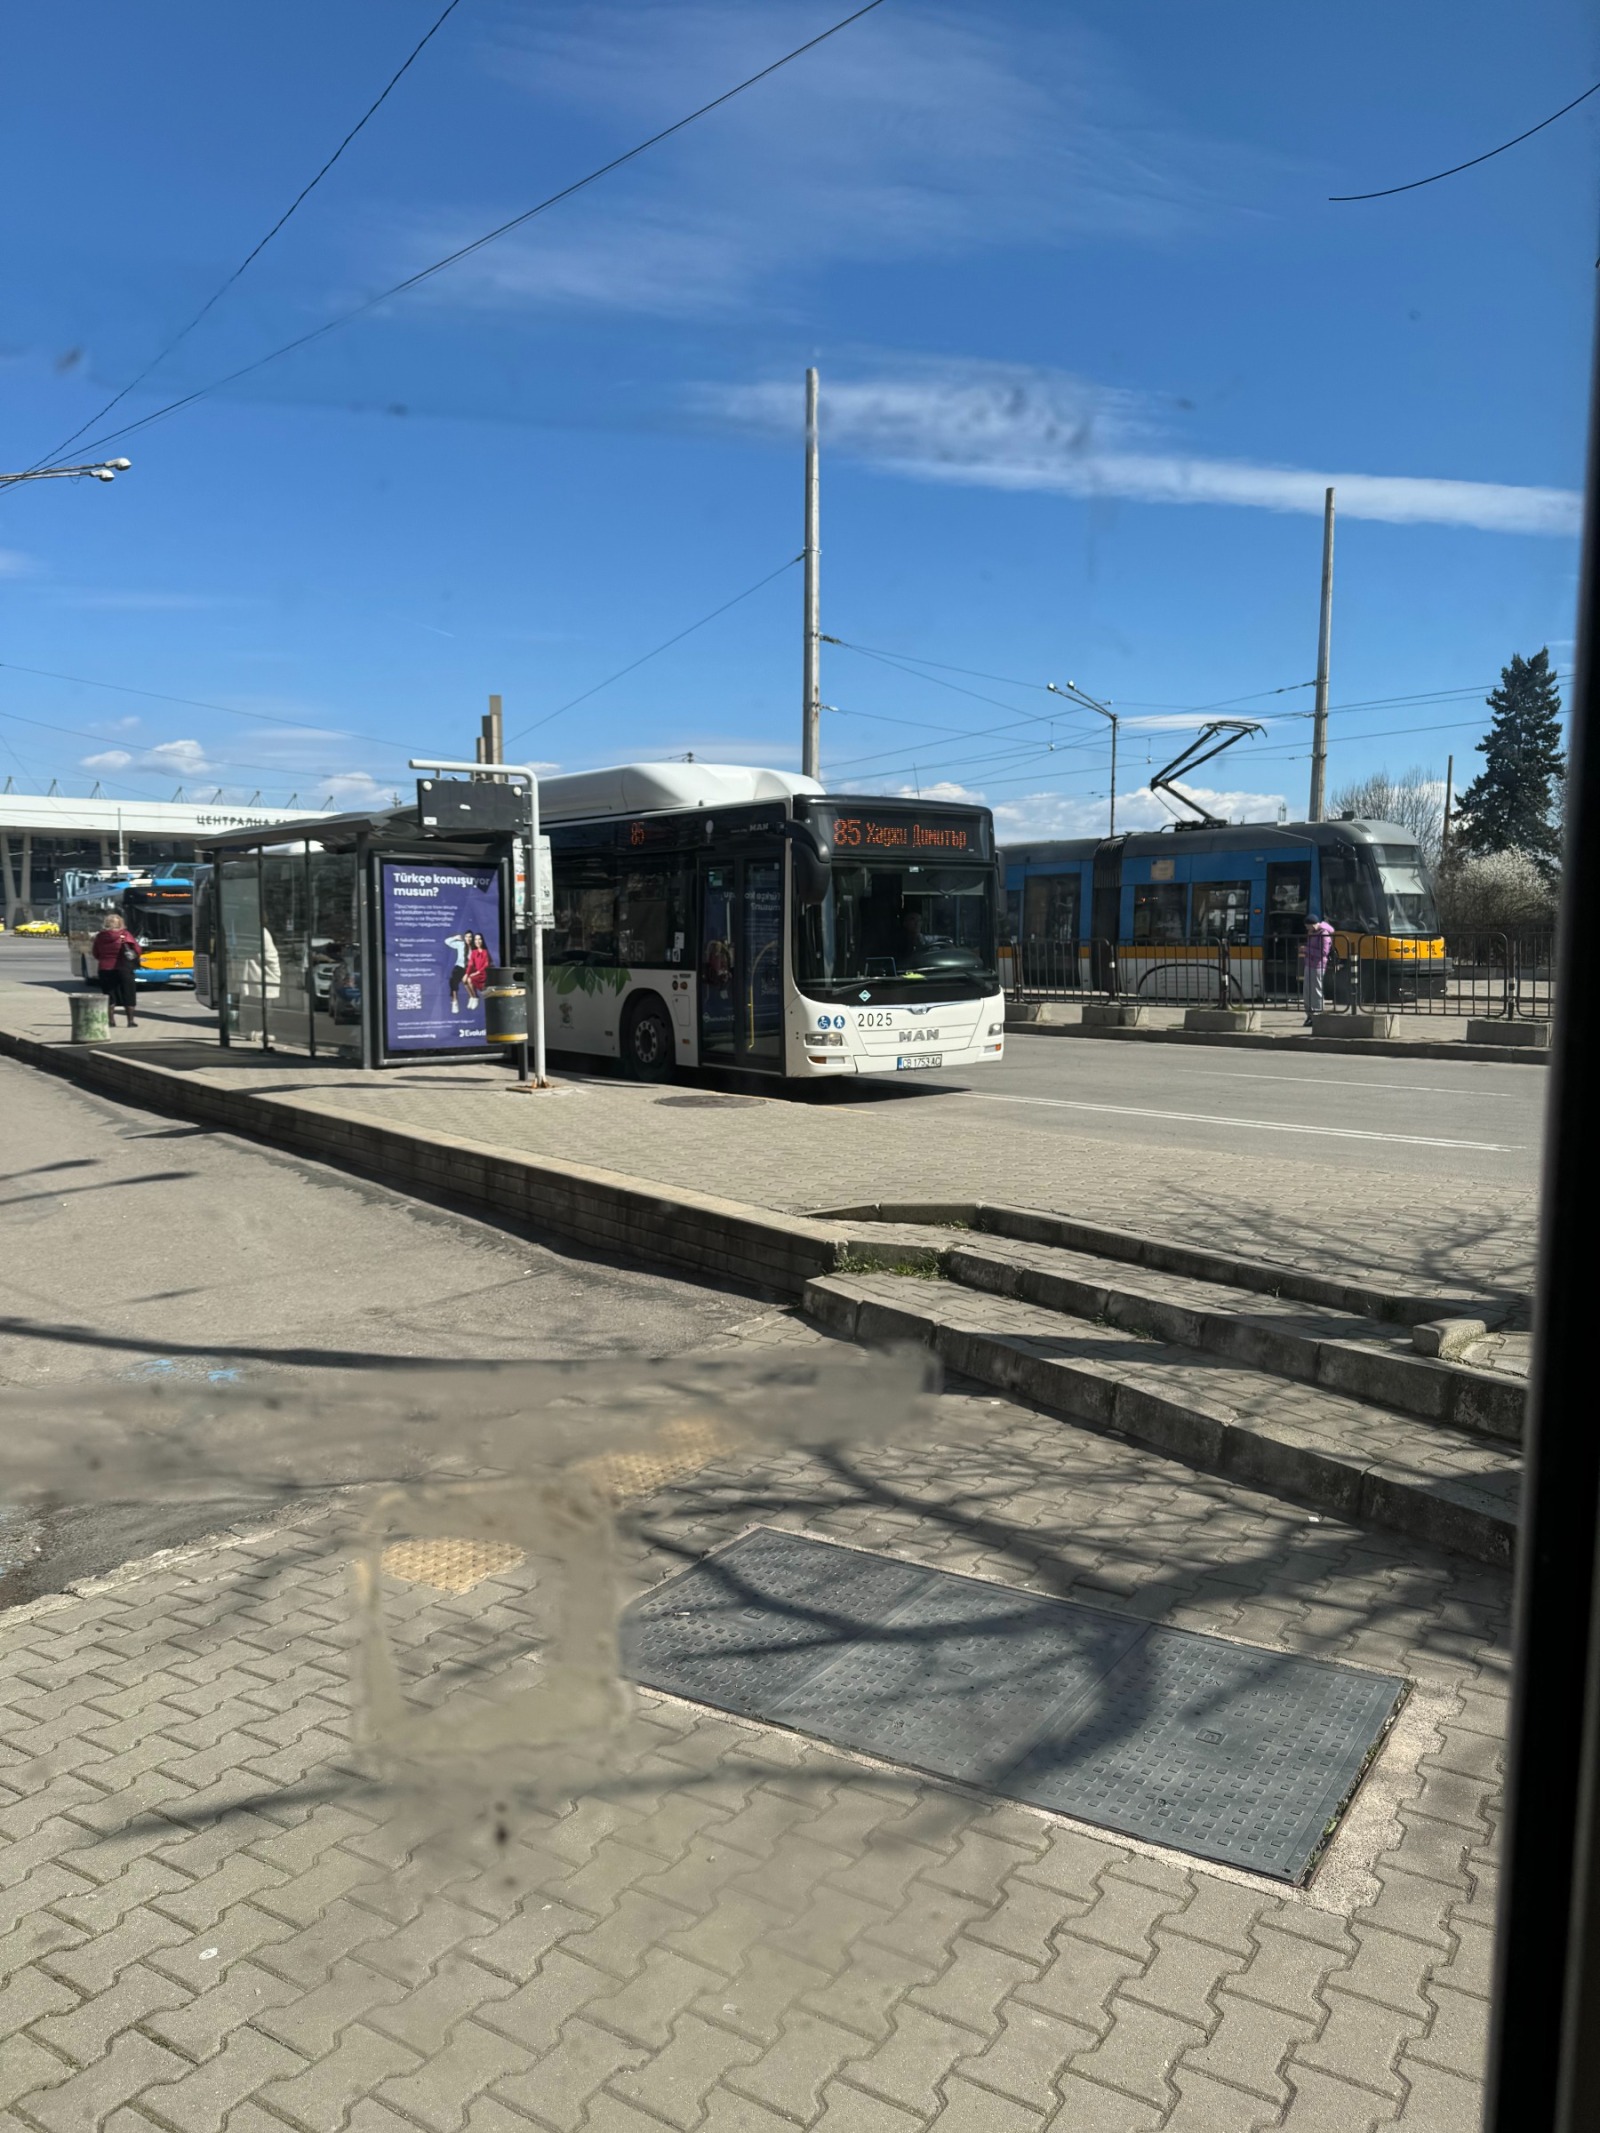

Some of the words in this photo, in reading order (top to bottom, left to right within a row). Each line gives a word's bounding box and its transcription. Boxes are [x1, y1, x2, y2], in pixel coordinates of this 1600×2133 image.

[632, 822, 645, 845] 85
[834, 819, 861, 846] 85
[866, 822, 908, 847] Хаджи
[913, 824, 967, 849] Димитър
[393, 872, 432, 887] Türkçe
[393, 887, 439, 897] musun?
[858, 1012, 893, 1027] 2025
[464, 1029, 487, 1037] Evoluti
[899, 1028, 940, 1042] MAN
